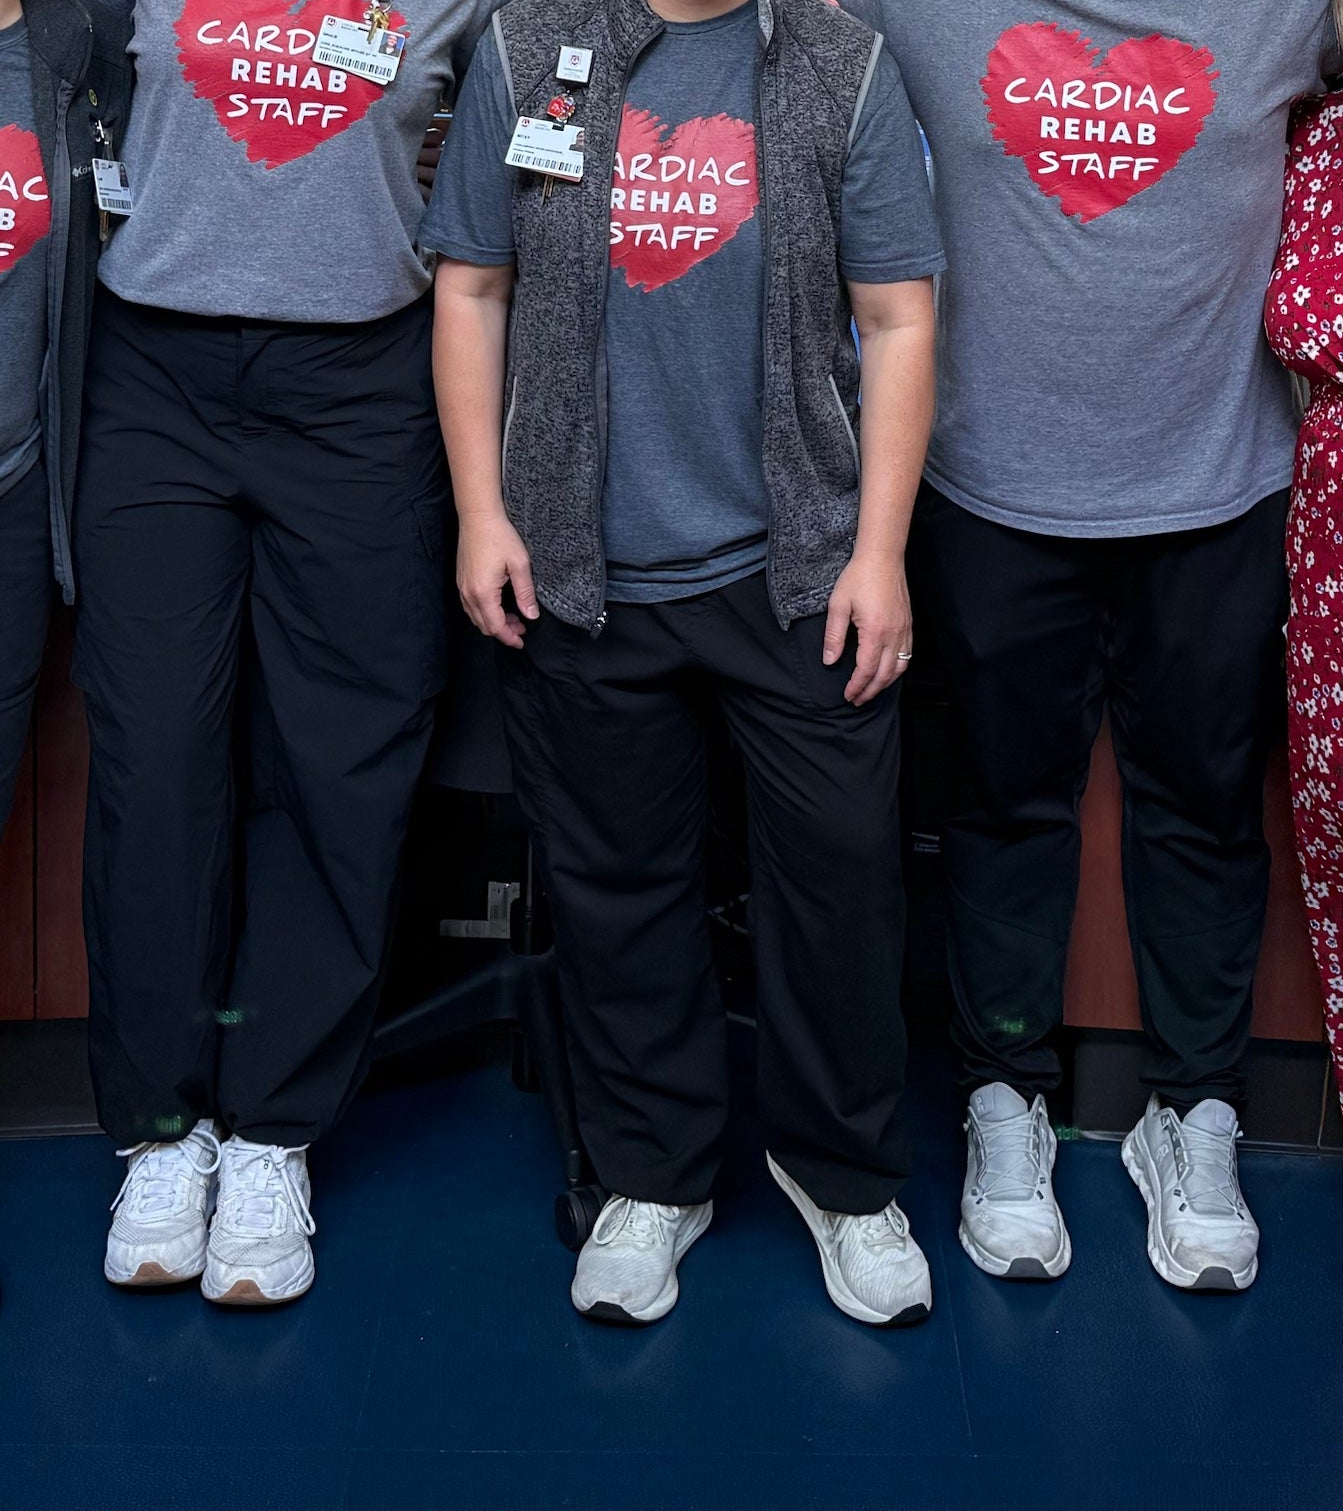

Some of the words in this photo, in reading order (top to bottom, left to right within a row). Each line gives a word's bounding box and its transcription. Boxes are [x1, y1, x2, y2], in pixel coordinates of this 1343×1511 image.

[197, 20, 316, 55] CARD
[231, 58, 348, 93] REHAB
[226, 94, 348, 128] STAFF
[1004, 77, 1190, 114] CARDIAC
[1040, 116, 1156, 146] REHAB
[613, 152, 750, 186] ARDIAC
[1038, 151, 1159, 180] STAFF
[610, 188, 717, 215] REHAB
[609, 221, 719, 250] STAFF
